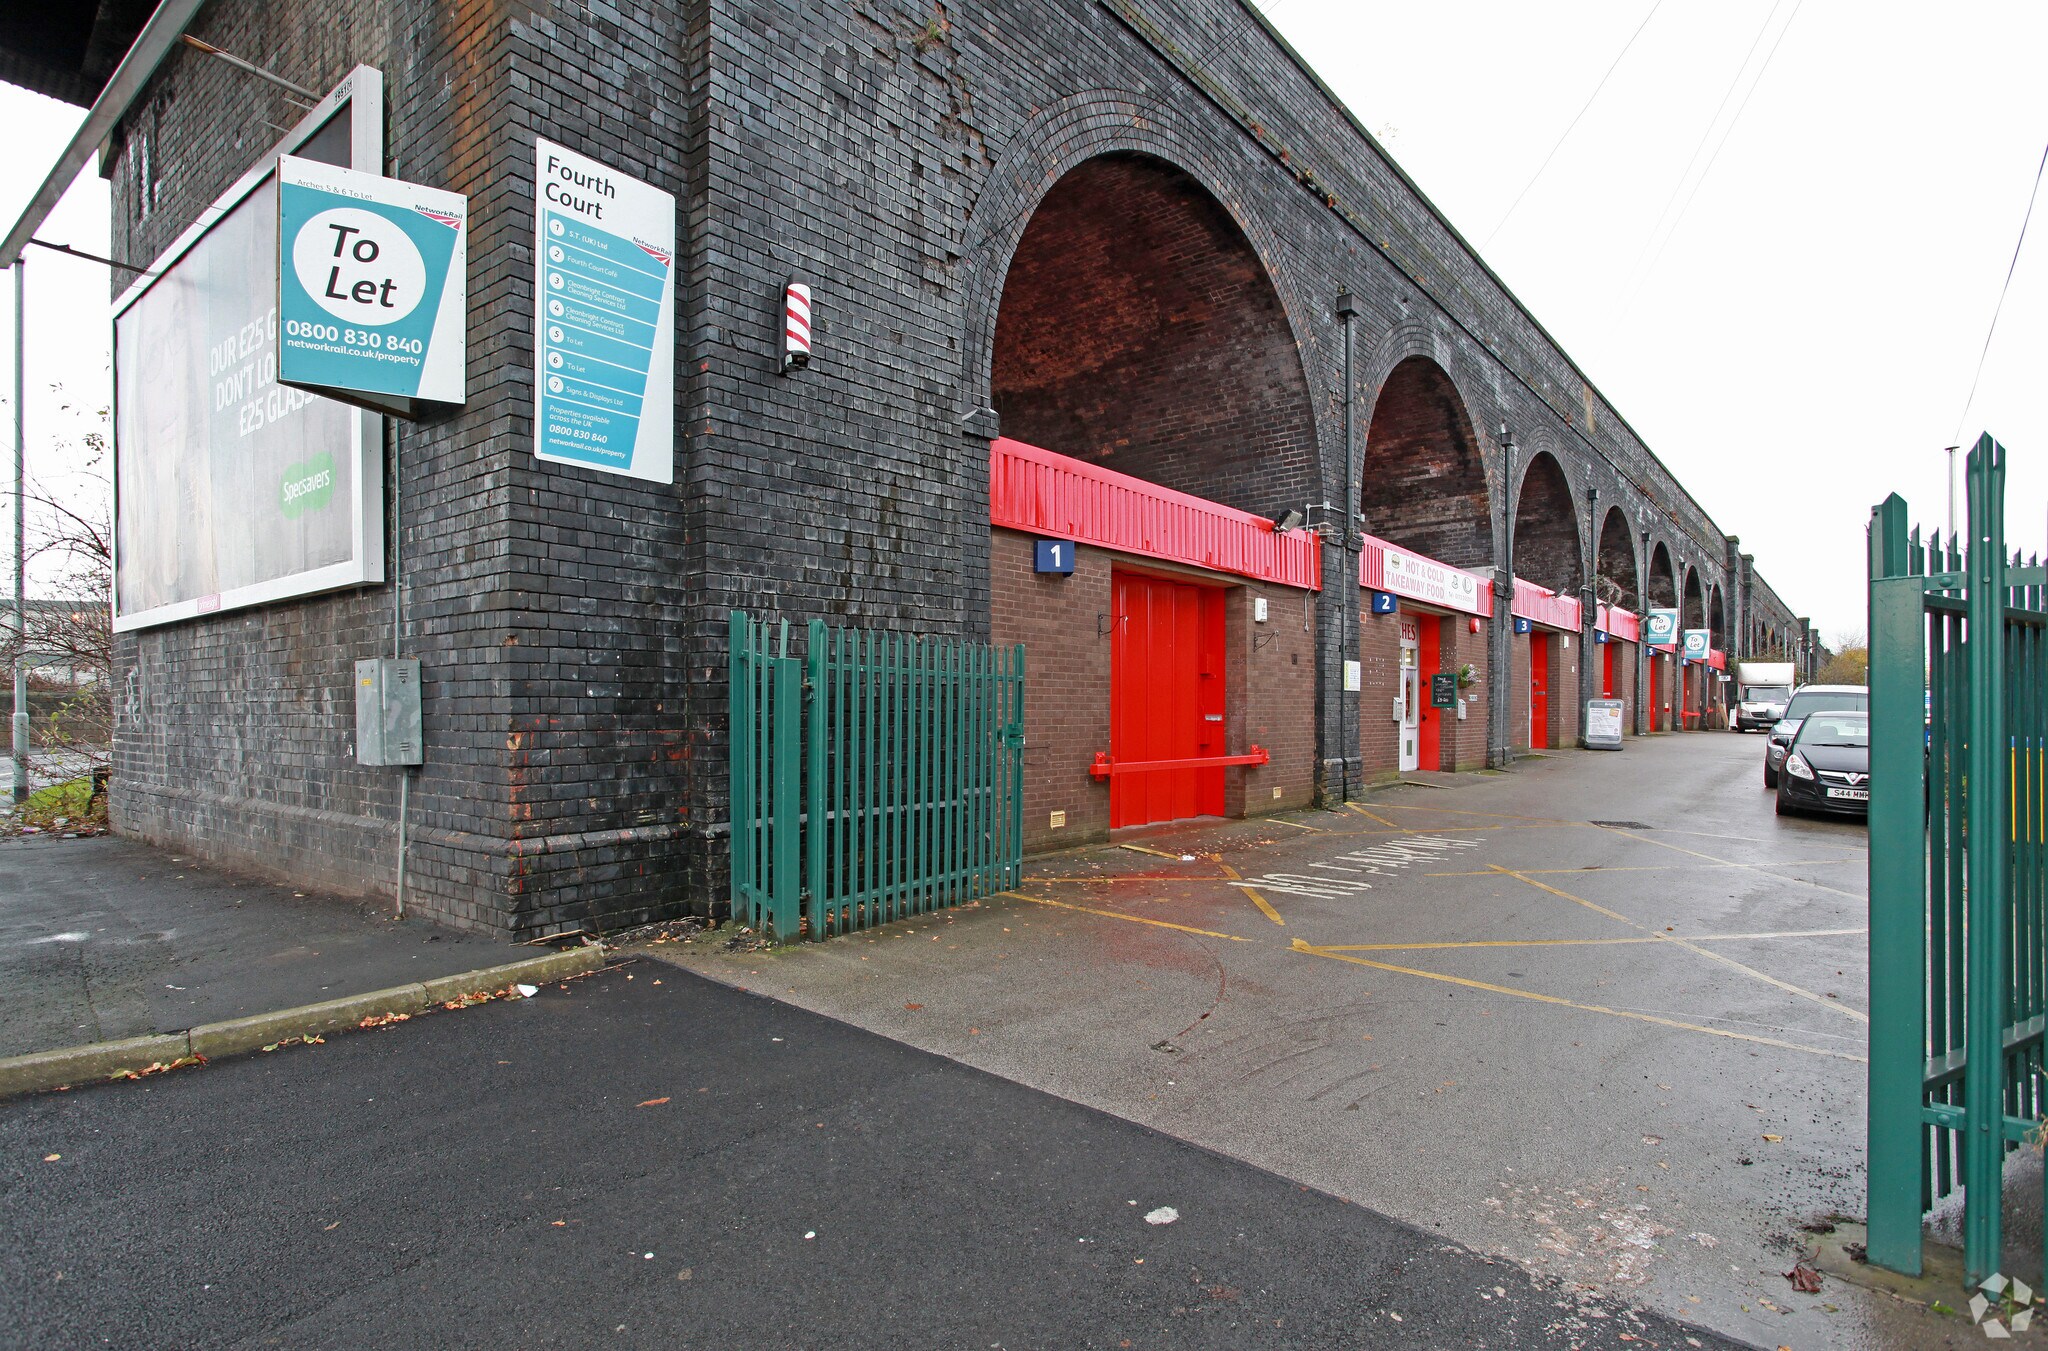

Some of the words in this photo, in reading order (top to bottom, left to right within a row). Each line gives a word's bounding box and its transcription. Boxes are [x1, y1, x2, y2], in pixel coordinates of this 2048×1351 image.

[547, 155, 616, 199] Fourth
[297, 179, 324, 191] Arches
[326, 184, 332, 192] 5
[333, 186, 340, 194] &
[341, 187, 347, 195] 6
[349, 189, 360, 198] To
[361, 191, 373, 200] Let
[545, 182, 603, 220] Court
[329, 223, 380, 263] To
[597, 241, 608, 250] Ltd
[567, 256, 588, 268] Fourth
[588, 263, 604, 274] Court
[325, 266, 398, 308] Let
[567, 279, 601, 297] Cleanbright
[601, 290, 626, 303] Contract
[567, 287, 593, 300] Cleaning
[594, 294, 616, 307] Services
[617, 301, 626, 310] Ltd
[566, 306, 599, 322] Cleanbright
[600, 316, 624, 329] Contract
[566, 313, 591, 326] Cleaning
[592, 321, 615, 333] Services
[615, 326, 625, 335] Ltd
[210, 336, 237, 377] OUR
[239, 316, 264, 360] £25
[286, 320, 338, 342] 0800
[344, 328, 381, 349] 830
[386, 335, 423, 355] 840
[287, 339, 421, 367] networkrail.co.uk/property
[552, 356, 558, 364] 6
[566, 362, 575, 370] To
[576, 365, 586, 373] Let
[216, 363, 255, 412] DON'T
[566, 386, 582, 396] Signs
[589, 392, 613, 404] Displays
[614, 398, 623, 406] Ltd
[239, 400, 265, 437] £25
[549, 404, 581, 418] Properties
[582, 412, 610, 425] available
[549, 414, 570, 424] across
[571, 418, 582, 426] the
[583, 420, 593, 428] UK
[549, 424, 572, 436] 0800
[573, 429, 590, 440] 830
[591, 433, 608, 444] 840
[549, 437, 626, 459] networkrail.co.uk/property
[283, 469, 330, 504] Specsavers
[1050, 545, 1060, 567] 1
[1405, 559, 1419, 576] HOT
[1421, 565, 1426, 577] &
[1427, 566, 1444, 583] COLD
[1386, 571, 1426, 595] TAKEAWAY
[1426, 583, 1444, 600] FOOD
[1382, 596, 1390, 610] 2
[1400, 622, 1416, 641] HES
[1521, 621, 1527, 631] 3
[1599, 633, 1605, 642] 4
[1834, 789, 1851, 797] S44
[1227, 873, 1373, 900] NO
